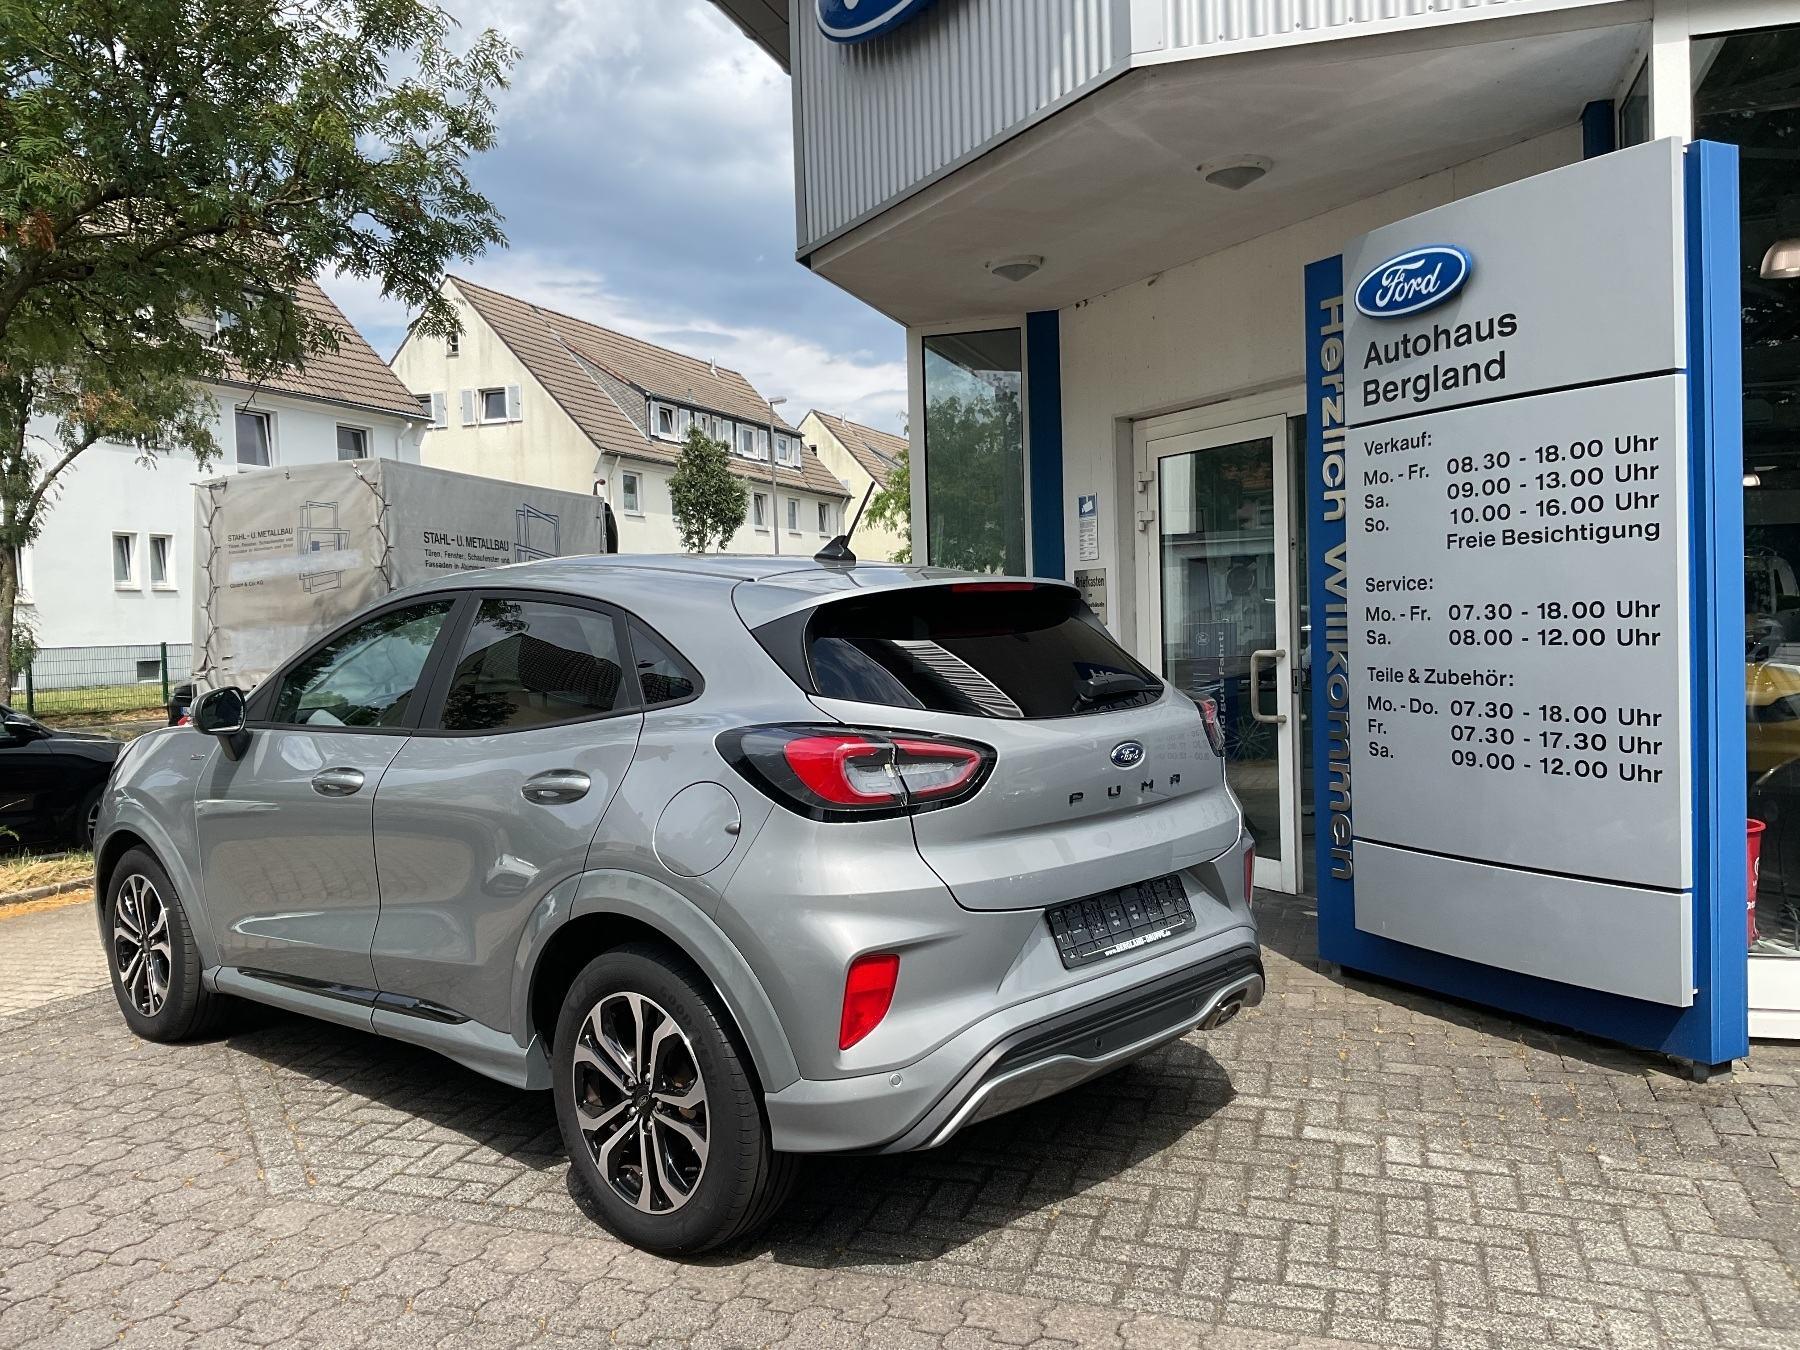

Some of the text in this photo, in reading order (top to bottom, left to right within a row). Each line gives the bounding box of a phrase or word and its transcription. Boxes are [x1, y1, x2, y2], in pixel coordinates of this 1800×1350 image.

[1375, 258, 1441, 308] Ford
[1364, 313, 1517, 369] Autohaus
[1364, 350, 1505, 407] Bergland
[1320, 295, 1346, 521] Herzlich
[1364, 431, 1431, 456] Verkauf:
[1615, 435, 1658, 454] Uhr
[1365, 494, 1388, 509] Sa.
[1615, 463, 1659, 482] Uhr
[1365, 518, 1389, 532] So.
[1616, 492, 1659, 510] Uhr
[466, 536, 509, 552] METALLBAU
[1447, 521, 1660, 549] Freie Besichtigung
[1075, 576, 1105, 588] Briefkasten
[1366, 576, 1433, 592] Service:
[1617, 600, 1660, 618] Uhr
[1367, 630, 1391, 645] Sa.
[1617, 629, 1660, 646] Uhr
[1367, 667, 1513, 686] Teile & Zubehör:
[1325, 541, 1353, 880] Willkommen
[1619, 708, 1662, 726] Uhr
[1368, 719, 1386, 734] Fr.
[1619, 736, 1662, 755] Uhr
[1369, 742, 1393, 758] Sa.
[1619, 763, 1663, 783] Uhr
[1069, 774, 1181, 804] PUMA
